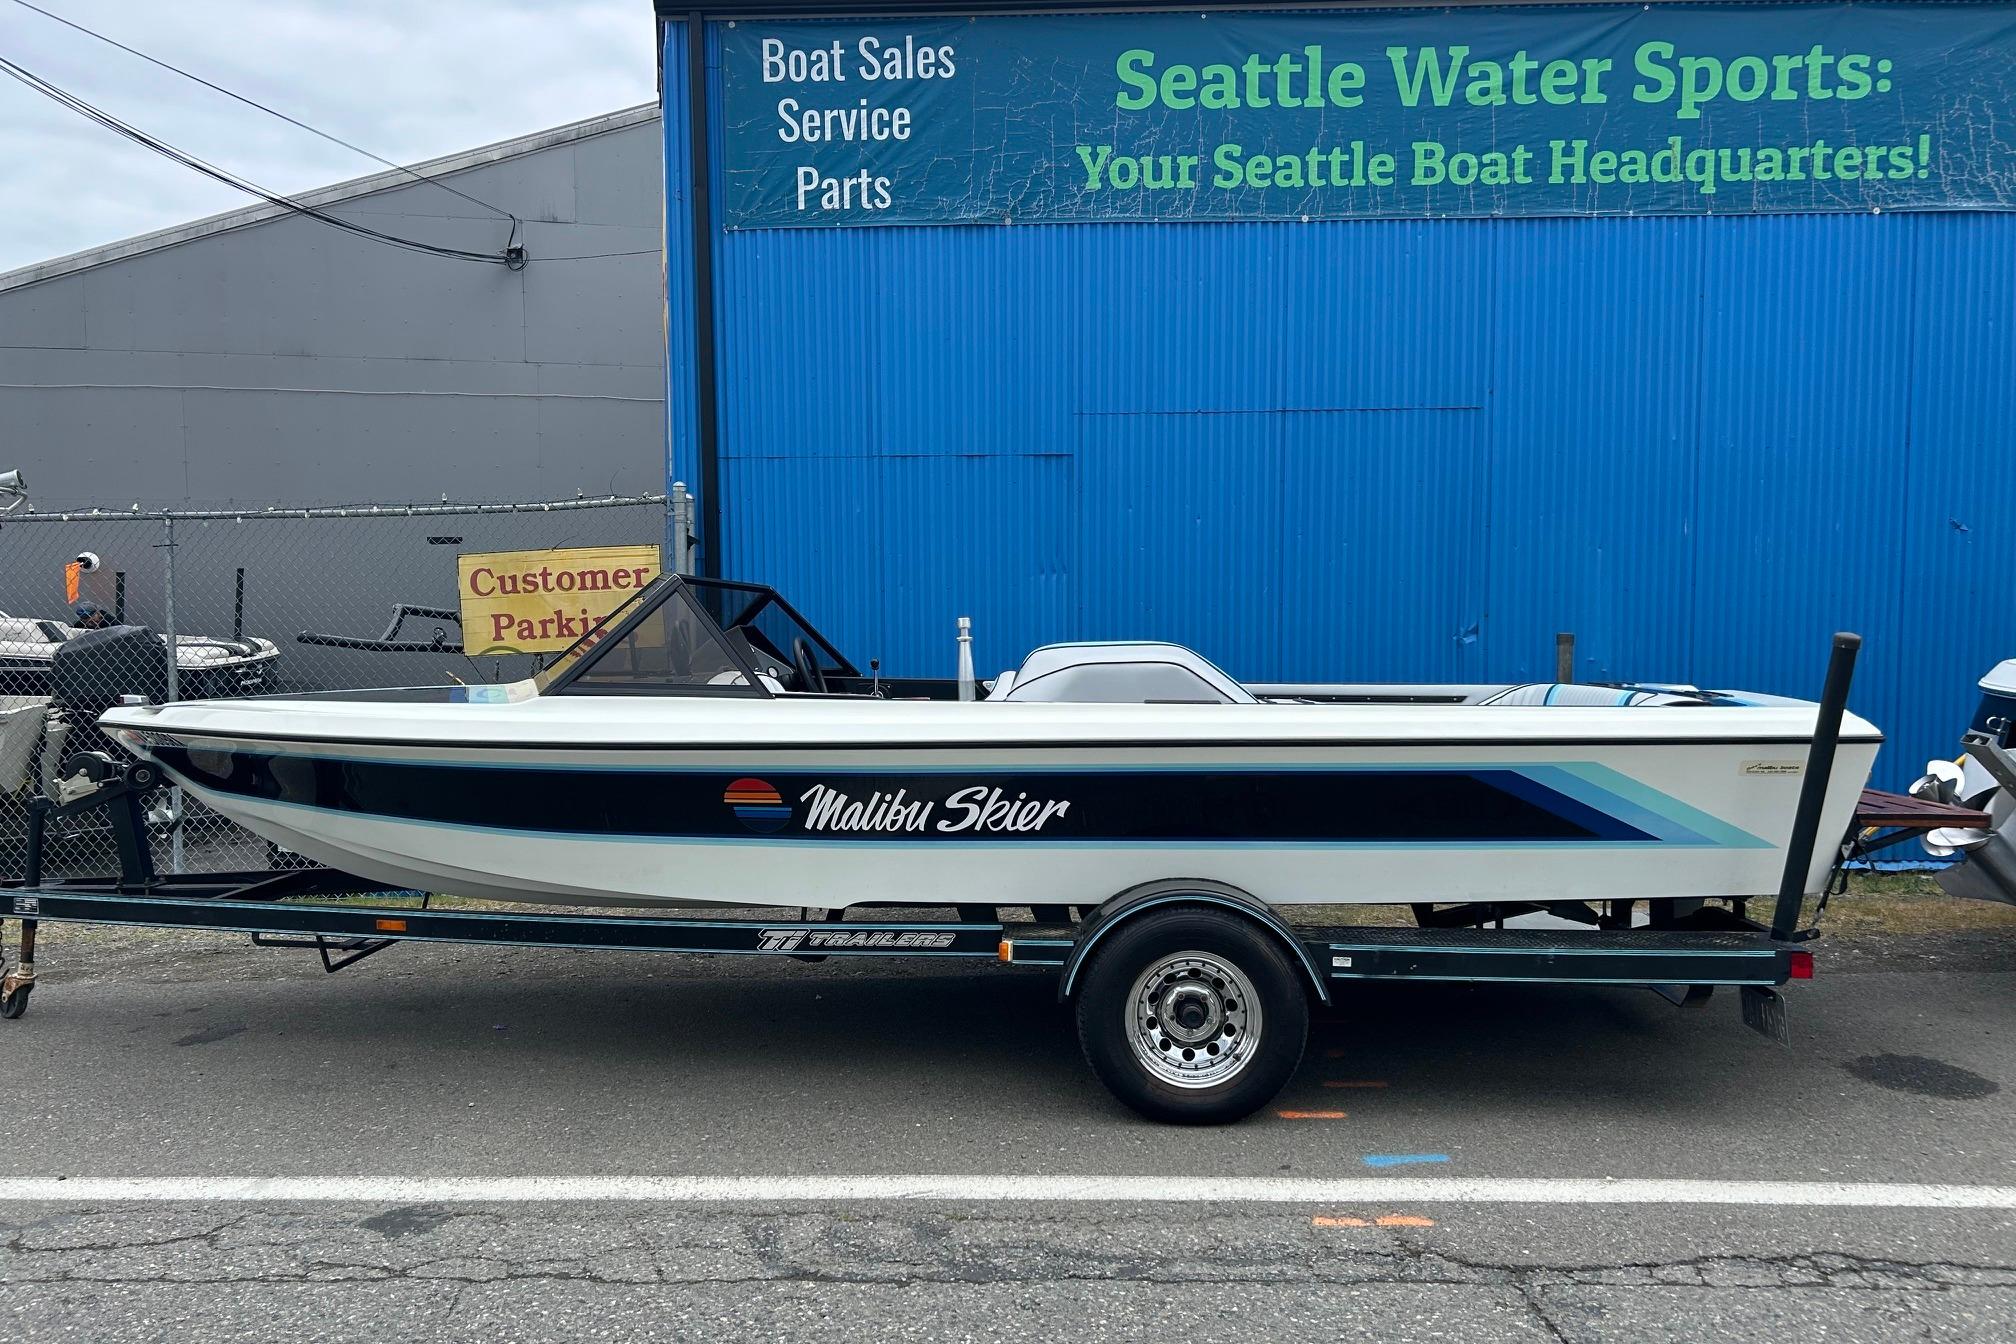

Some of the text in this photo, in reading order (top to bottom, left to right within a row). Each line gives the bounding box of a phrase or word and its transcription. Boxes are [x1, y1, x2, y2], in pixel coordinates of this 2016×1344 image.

[763, 36, 955, 82] Boat Sales
[1118, 43, 1891, 117] Seattle Water Sports:
[778, 99, 910, 142] Service
[1078, 136, 1928, 192] Your Seattle Boat Headquarters!
[798, 167, 891, 209] Parts
[470, 566, 650, 597] Customer
[491, 608, 609, 641] Parki
[800, 784, 1070, 831] Malibu Skier
[809, 931, 956, 948] TRAILERS
